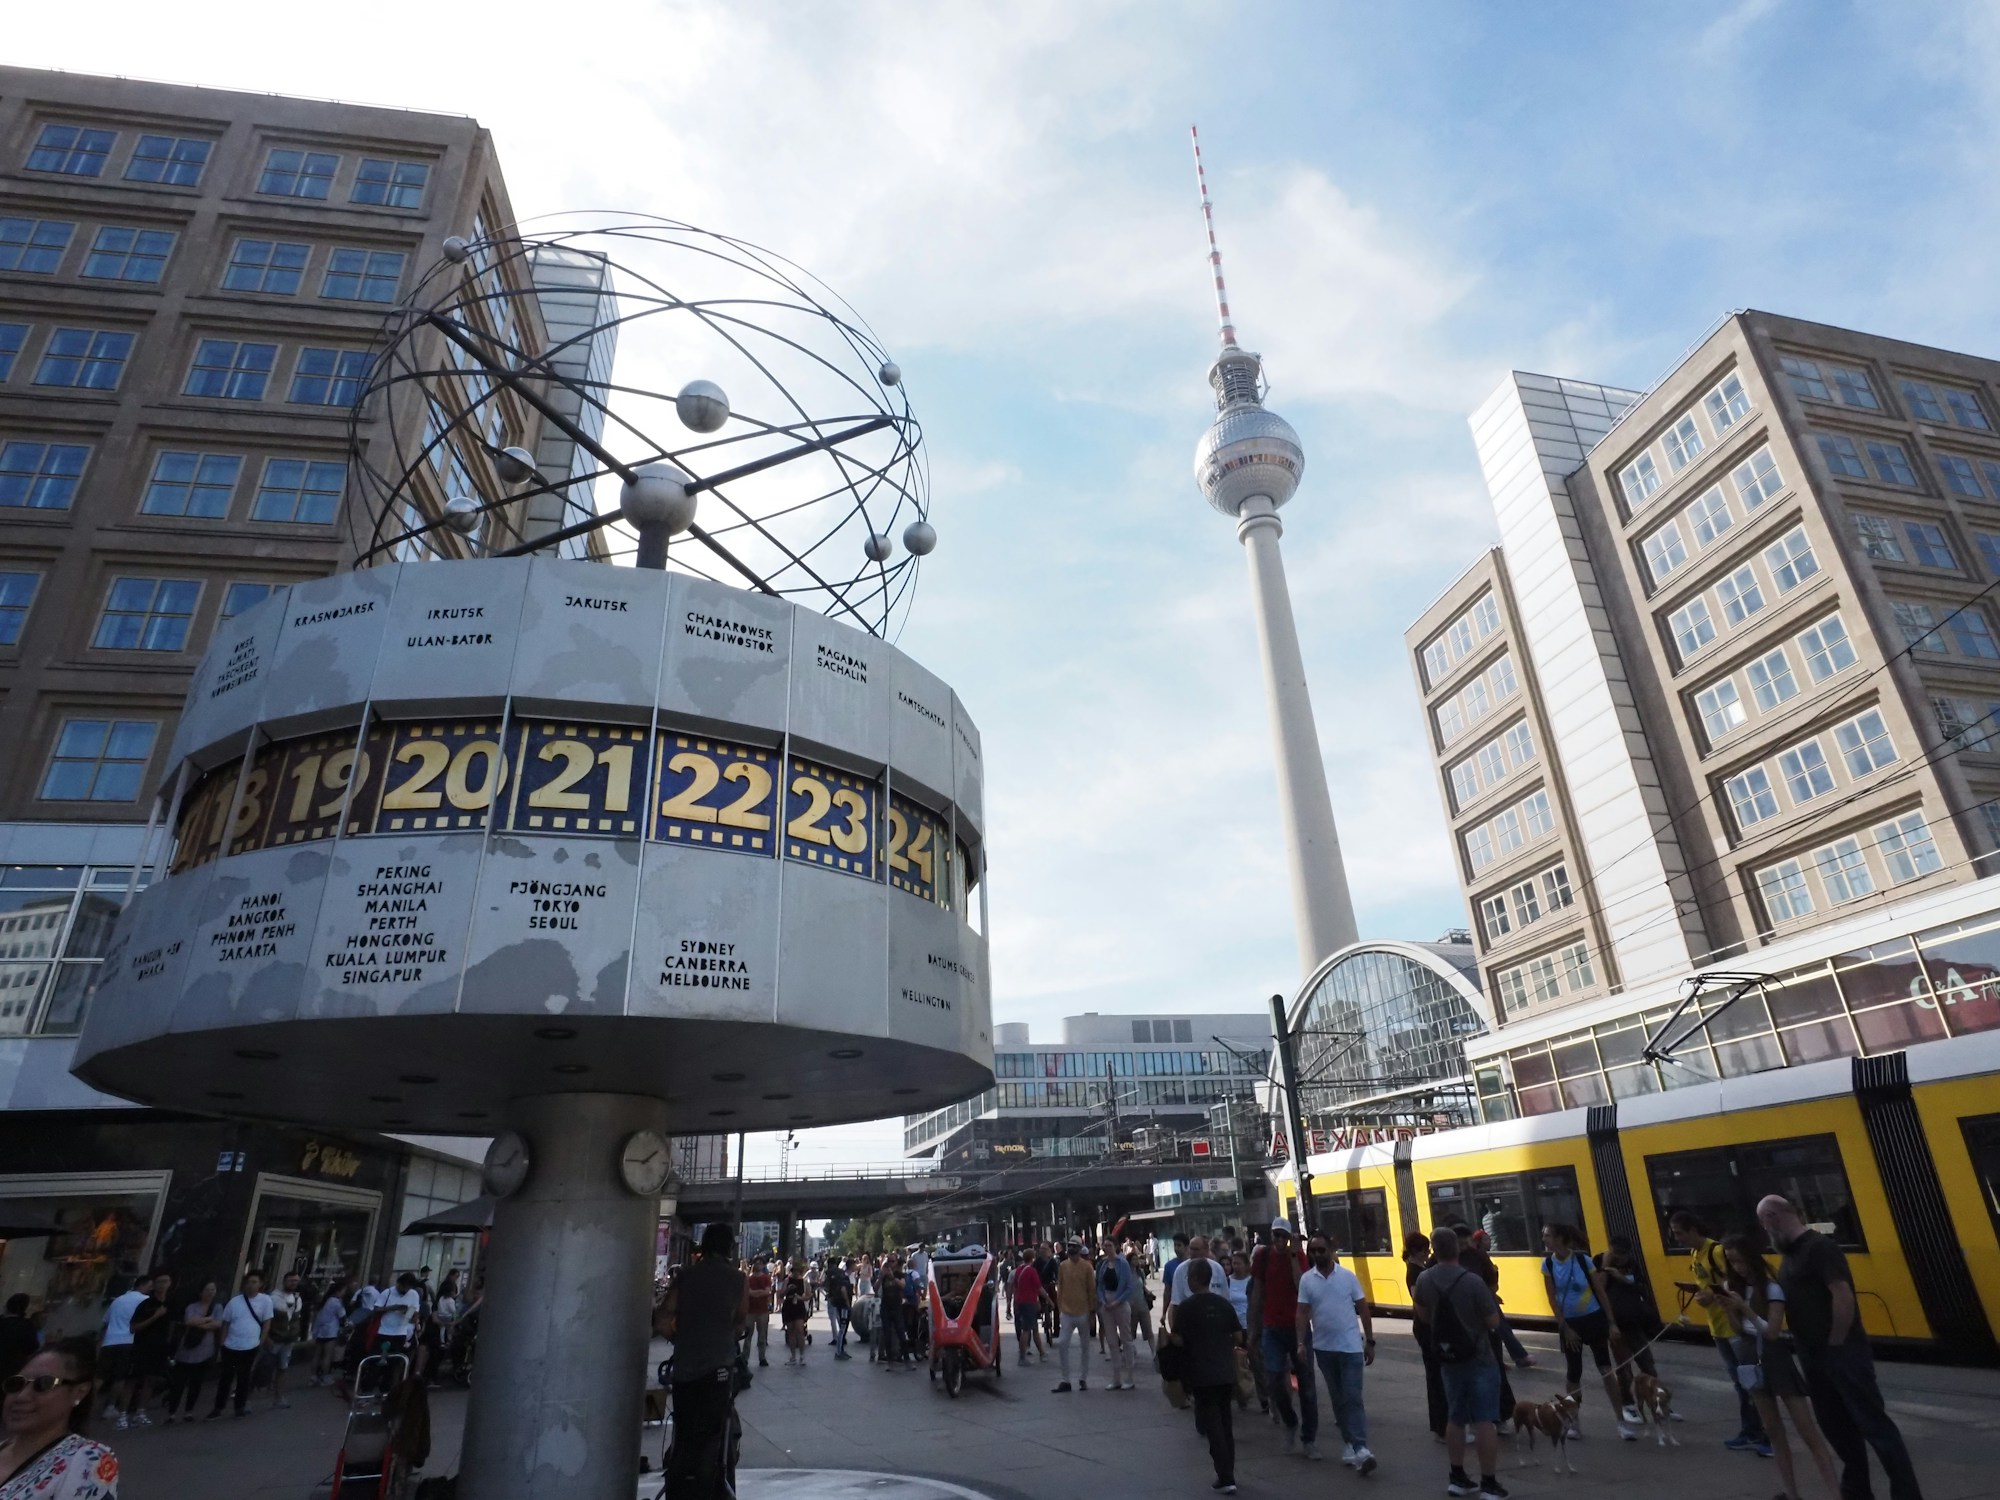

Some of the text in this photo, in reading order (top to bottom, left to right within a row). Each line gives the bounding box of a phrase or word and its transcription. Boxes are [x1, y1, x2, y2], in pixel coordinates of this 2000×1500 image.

[566, 597, 627, 611] JAKUTSK
[295, 602, 374, 627] KRASNOJARSK
[428, 608, 483, 619] IRKUTSK
[686, 613, 772, 640] CHABAROWSK
[408, 634, 491, 647] ULAN-BATOR
[686, 625, 773, 653] WLADIWOSTOK
[818, 645, 866, 671] MAGADAN
[818, 658, 866, 683] SACHALIN
[899, 692, 945, 728] KAMTSCHATKA
[383, 740, 508, 811] 20
[529, 740, 633, 812] 21
[288, 748, 371, 824] 19
[661, 752, 773, 831] 22
[787, 776, 868, 854] 23
[881, 806, 932, 885] 24
[376, 866, 430, 879] PEKING
[358, 882, 442, 896] SHANGHAI
[511, 880, 606, 897] PJÖNGJANG
[241, 893, 281, 909] HANOI
[365, 899, 426, 913] MANILA
[534, 900, 579, 912] TOKYO
[229, 909, 285, 927] BANGKOK
[370, 916, 417, 930] PERTH
[529, 917, 577, 929] SEOUL
[211, 924, 295, 945] PHNOM PENH
[347, 933, 434, 948] HONGKONG
[219, 943, 275, 961] JAKARTA
[682, 941, 734, 955] SYDNEY
[326, 950, 446, 966] KUALA LUMPUR
[665, 956, 747, 973] CANBERRA
[928, 954, 957, 972] DATUMS
[343, 969, 421, 984] SINGAPUR
[660, 973, 749, 990] MELBOURNE
[1910, 967, 1979, 1009] C&A
[902, 989, 950, 1010] WELLINGTON
[1271, 1127, 1450, 1156] AEXAND
